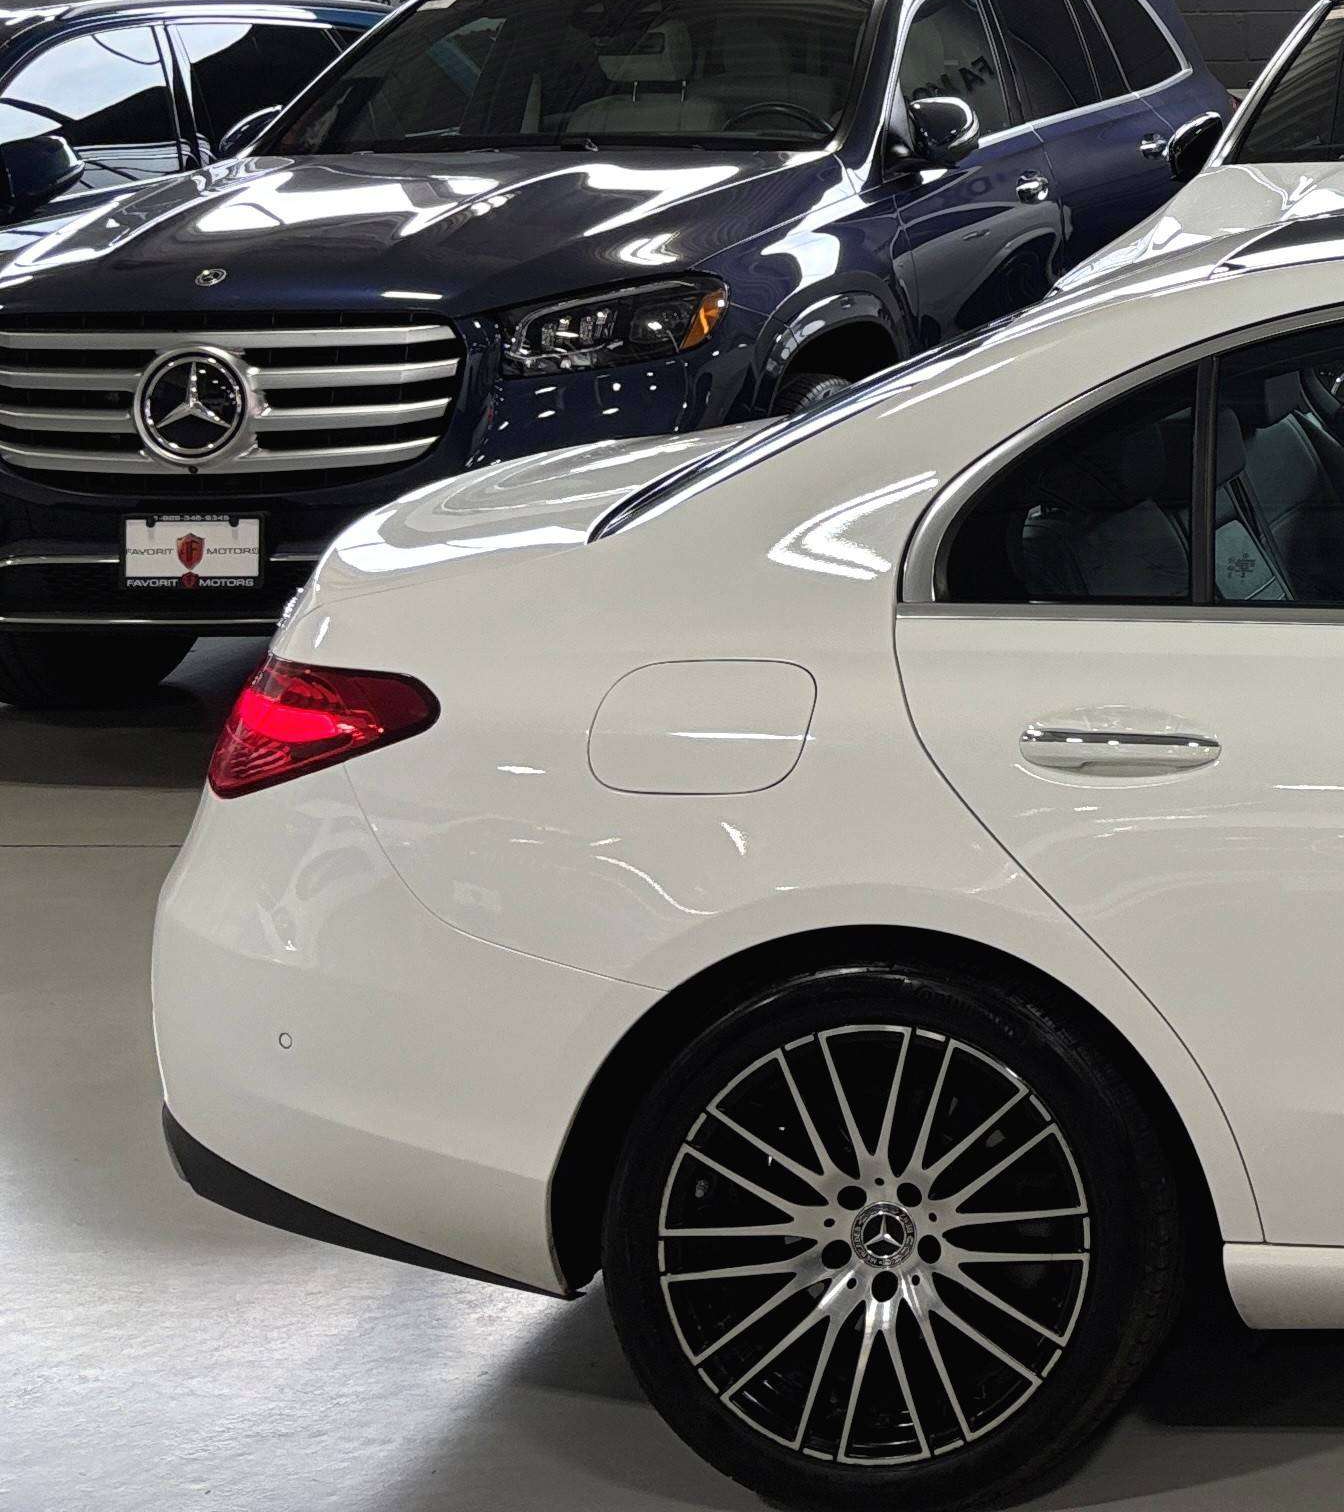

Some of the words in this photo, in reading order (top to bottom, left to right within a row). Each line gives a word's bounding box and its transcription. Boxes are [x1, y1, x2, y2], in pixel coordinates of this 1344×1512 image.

[127, 548, 174, 556] FAVORIT
[127, 578, 179, 587] FAVORIT
[199, 578, 255, 587] MOTORS
